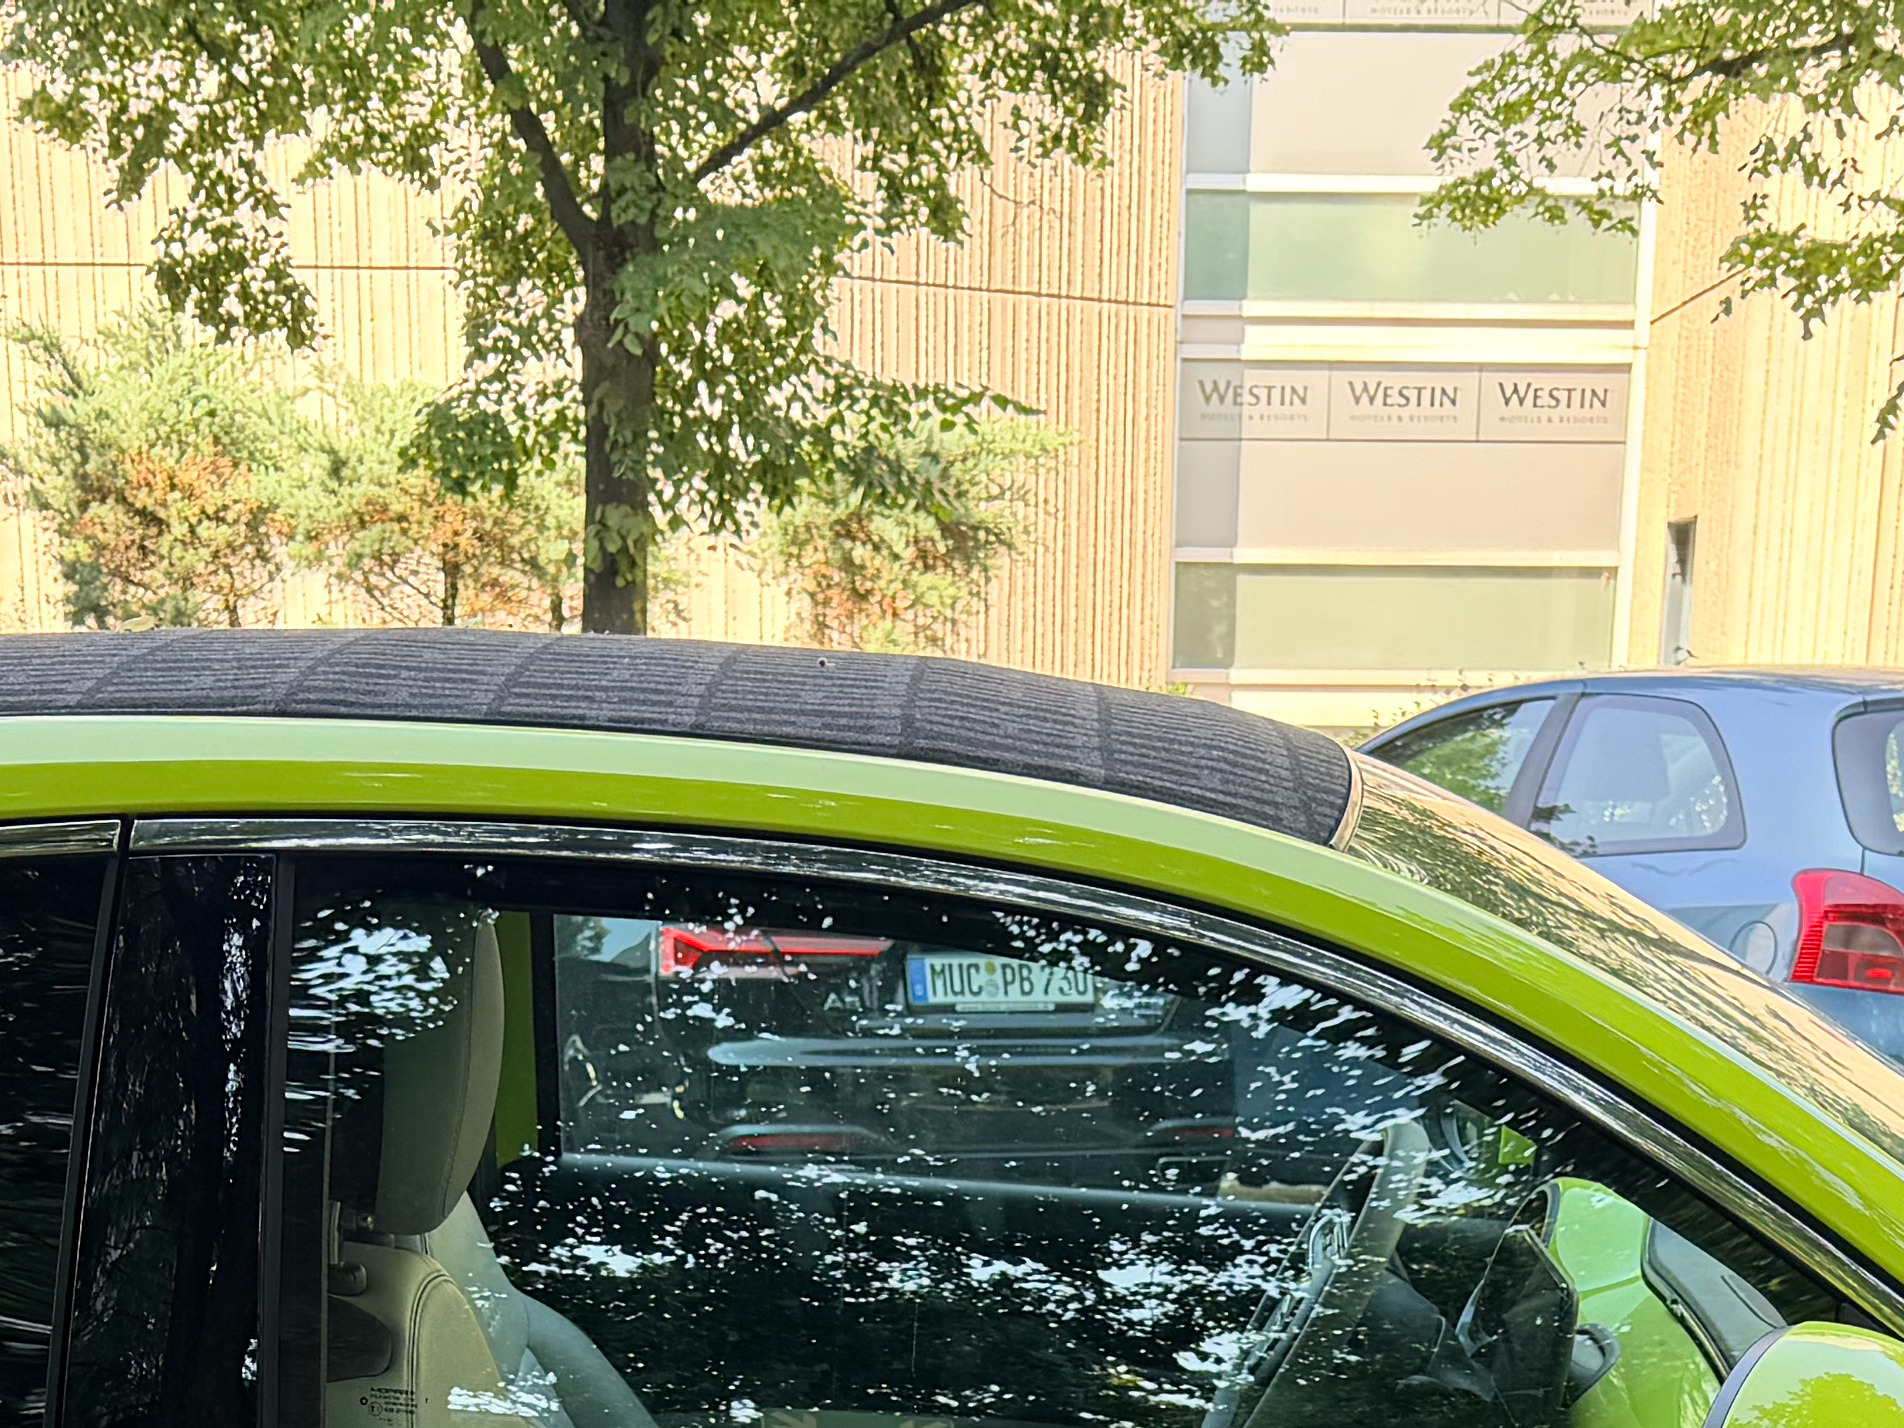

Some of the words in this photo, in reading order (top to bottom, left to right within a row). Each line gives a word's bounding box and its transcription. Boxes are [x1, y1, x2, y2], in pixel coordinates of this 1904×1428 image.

[1198, 379, 1309, 406] WESTIN
[1347, 380, 1458, 407] WESTIN
[1498, 382, 1610, 409] WESTIN
[930, 962, 983, 996] MUC
[1003, 963, 1034, 996] PB
[1040, 964, 1088, 996] 730
